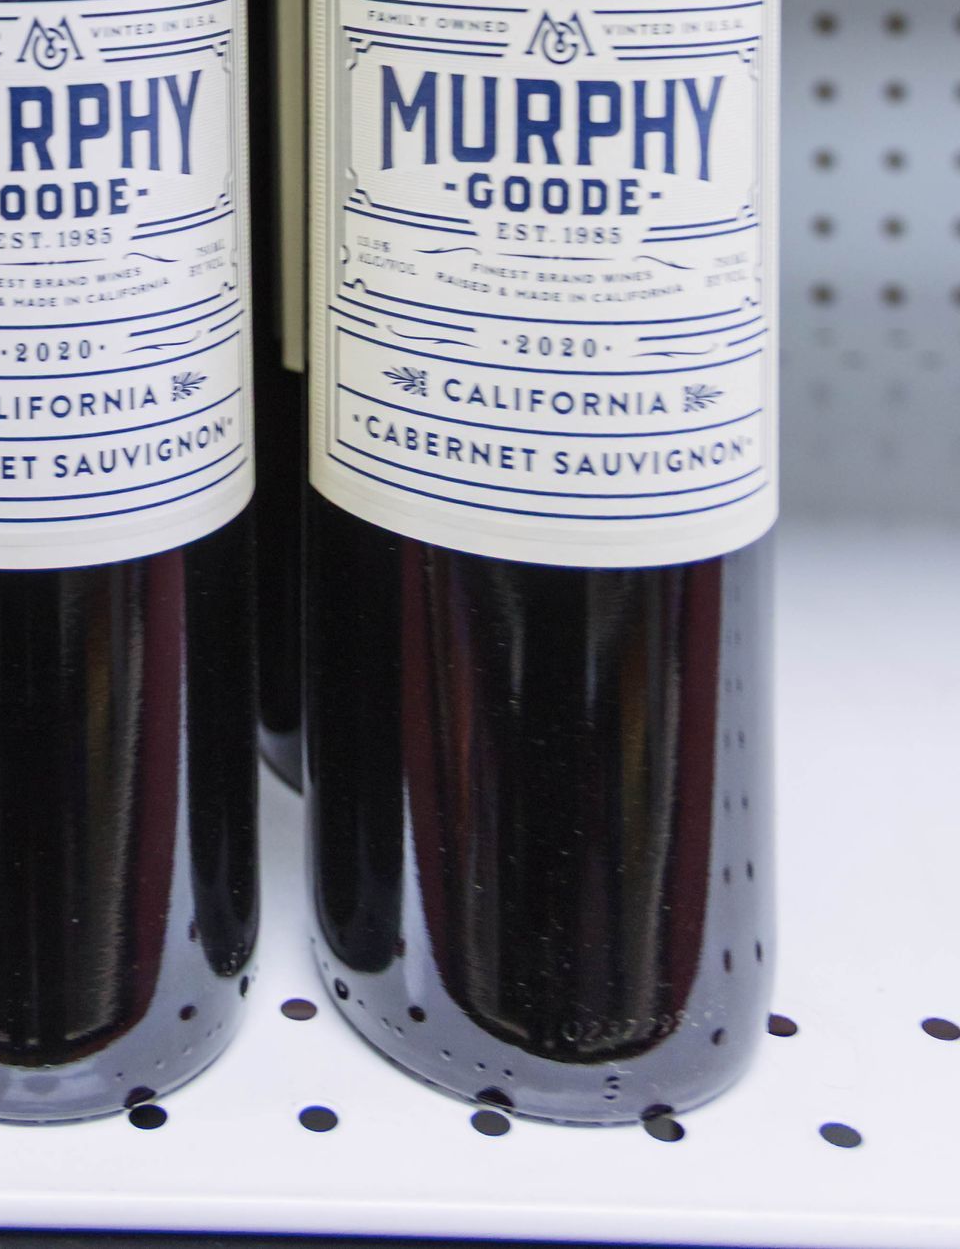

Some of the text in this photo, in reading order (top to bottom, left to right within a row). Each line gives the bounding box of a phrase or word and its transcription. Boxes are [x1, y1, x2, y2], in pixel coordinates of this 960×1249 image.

[91, 22, 155, 38] VINTED
[367, 9, 509, 33] FAMILY OWNED
[602, 23, 674, 36] VINTED
[380, 64, 725, 182] MURPHY
[33, 276, 88, 289] BRAND
[96, 267, 141, 283] WINES
[471, 262, 529, 279] FINEST
[537, 271, 594, 284] BRAND
[13, 297, 57, 307] MADE
[87, 276, 170, 304] CALIFORNIA
[515, 289, 560, 302] MADE
[443, 378, 669, 416] CALIFORNIA
